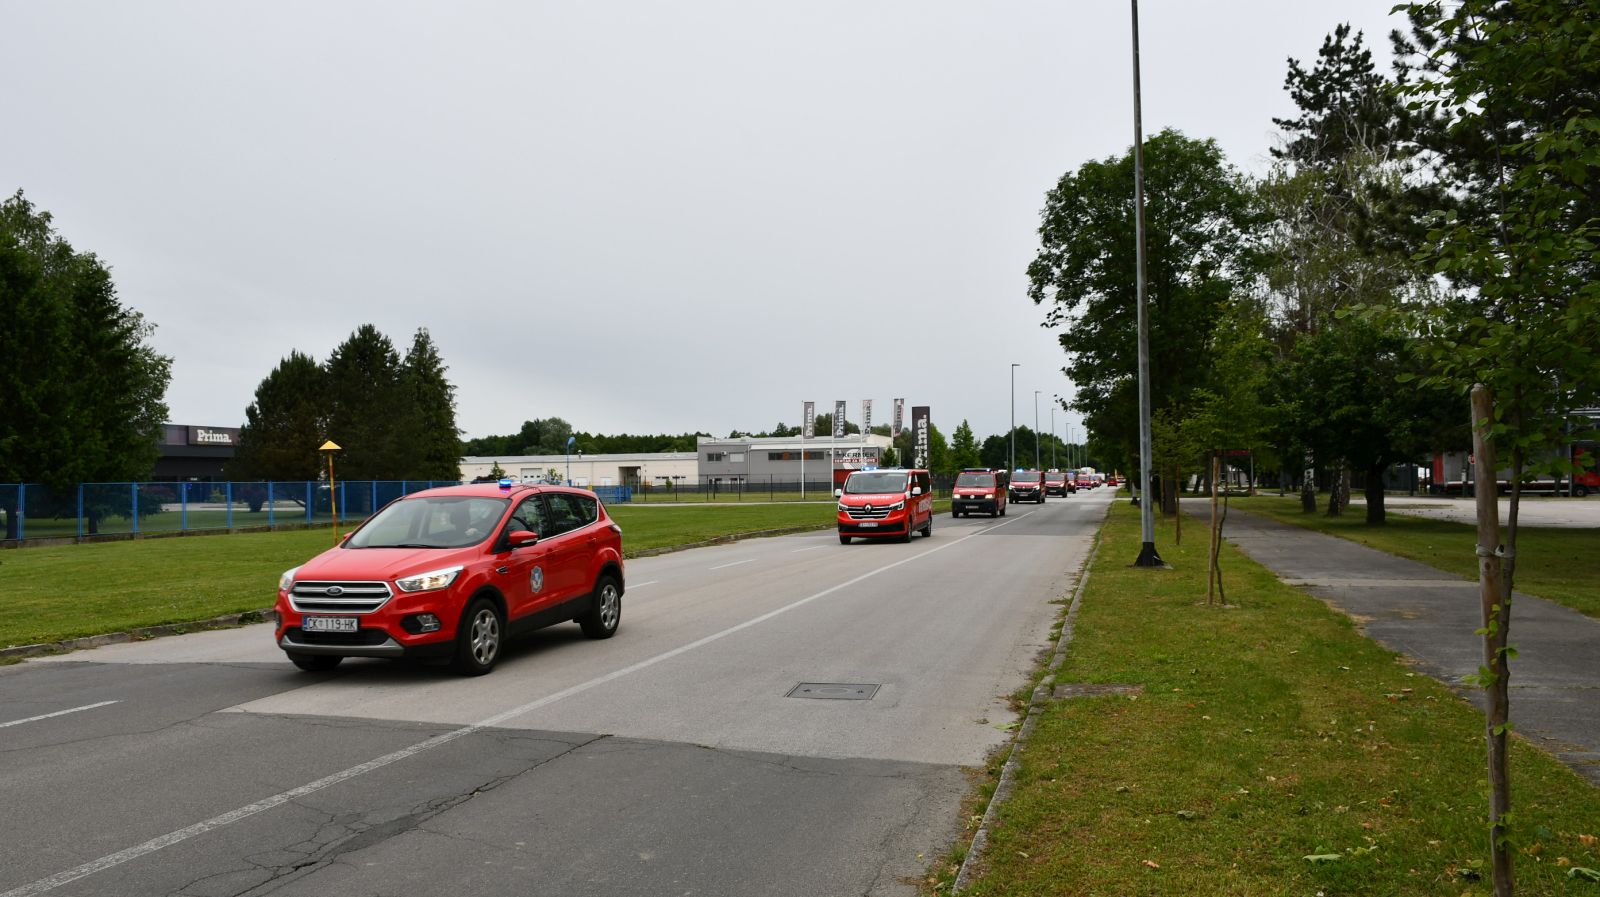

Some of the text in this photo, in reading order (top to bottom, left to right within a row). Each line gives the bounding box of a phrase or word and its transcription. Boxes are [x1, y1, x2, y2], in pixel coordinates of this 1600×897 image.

[805, 405, 813, 436] Prima.
[836, 404, 844, 436] Prima.
[197, 429, 232, 443] Prima.
